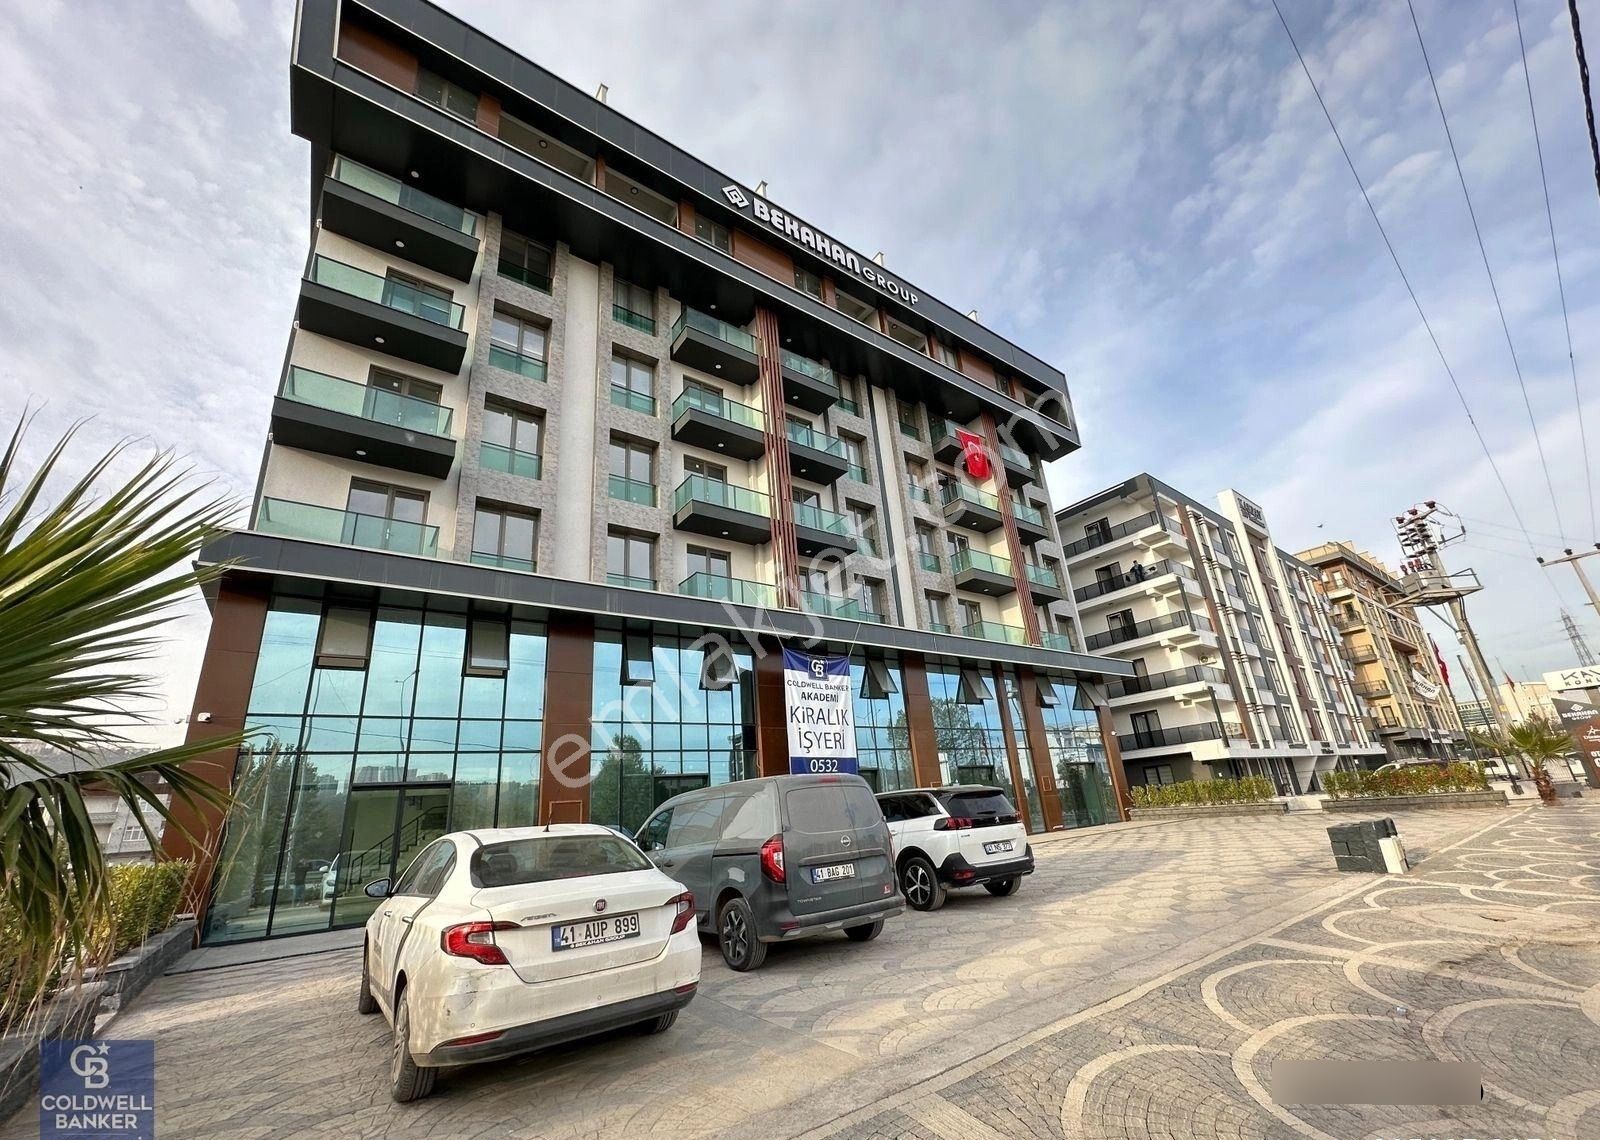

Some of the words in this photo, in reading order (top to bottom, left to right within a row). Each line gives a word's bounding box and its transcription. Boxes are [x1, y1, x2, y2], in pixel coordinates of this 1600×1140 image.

[753, 197, 860, 275] BEKAHAN
[862, 266, 919, 305] GROUP
[787, 680, 823, 690] COLDWELL
[824, 683, 849, 692] BANKER
[801, 691, 839, 703] AKADEMİ
[798, 727, 845, 753] İŞYERİ
[810, 759, 838, 772] 0532
[816, 869, 824, 879] 41
[827, 866, 840, 877] BAG
[842, 864, 854, 875] 201
[561, 926, 575, 943] 41
[584, 921, 608, 940] AUP
[614, 916, 637, 934] 899
